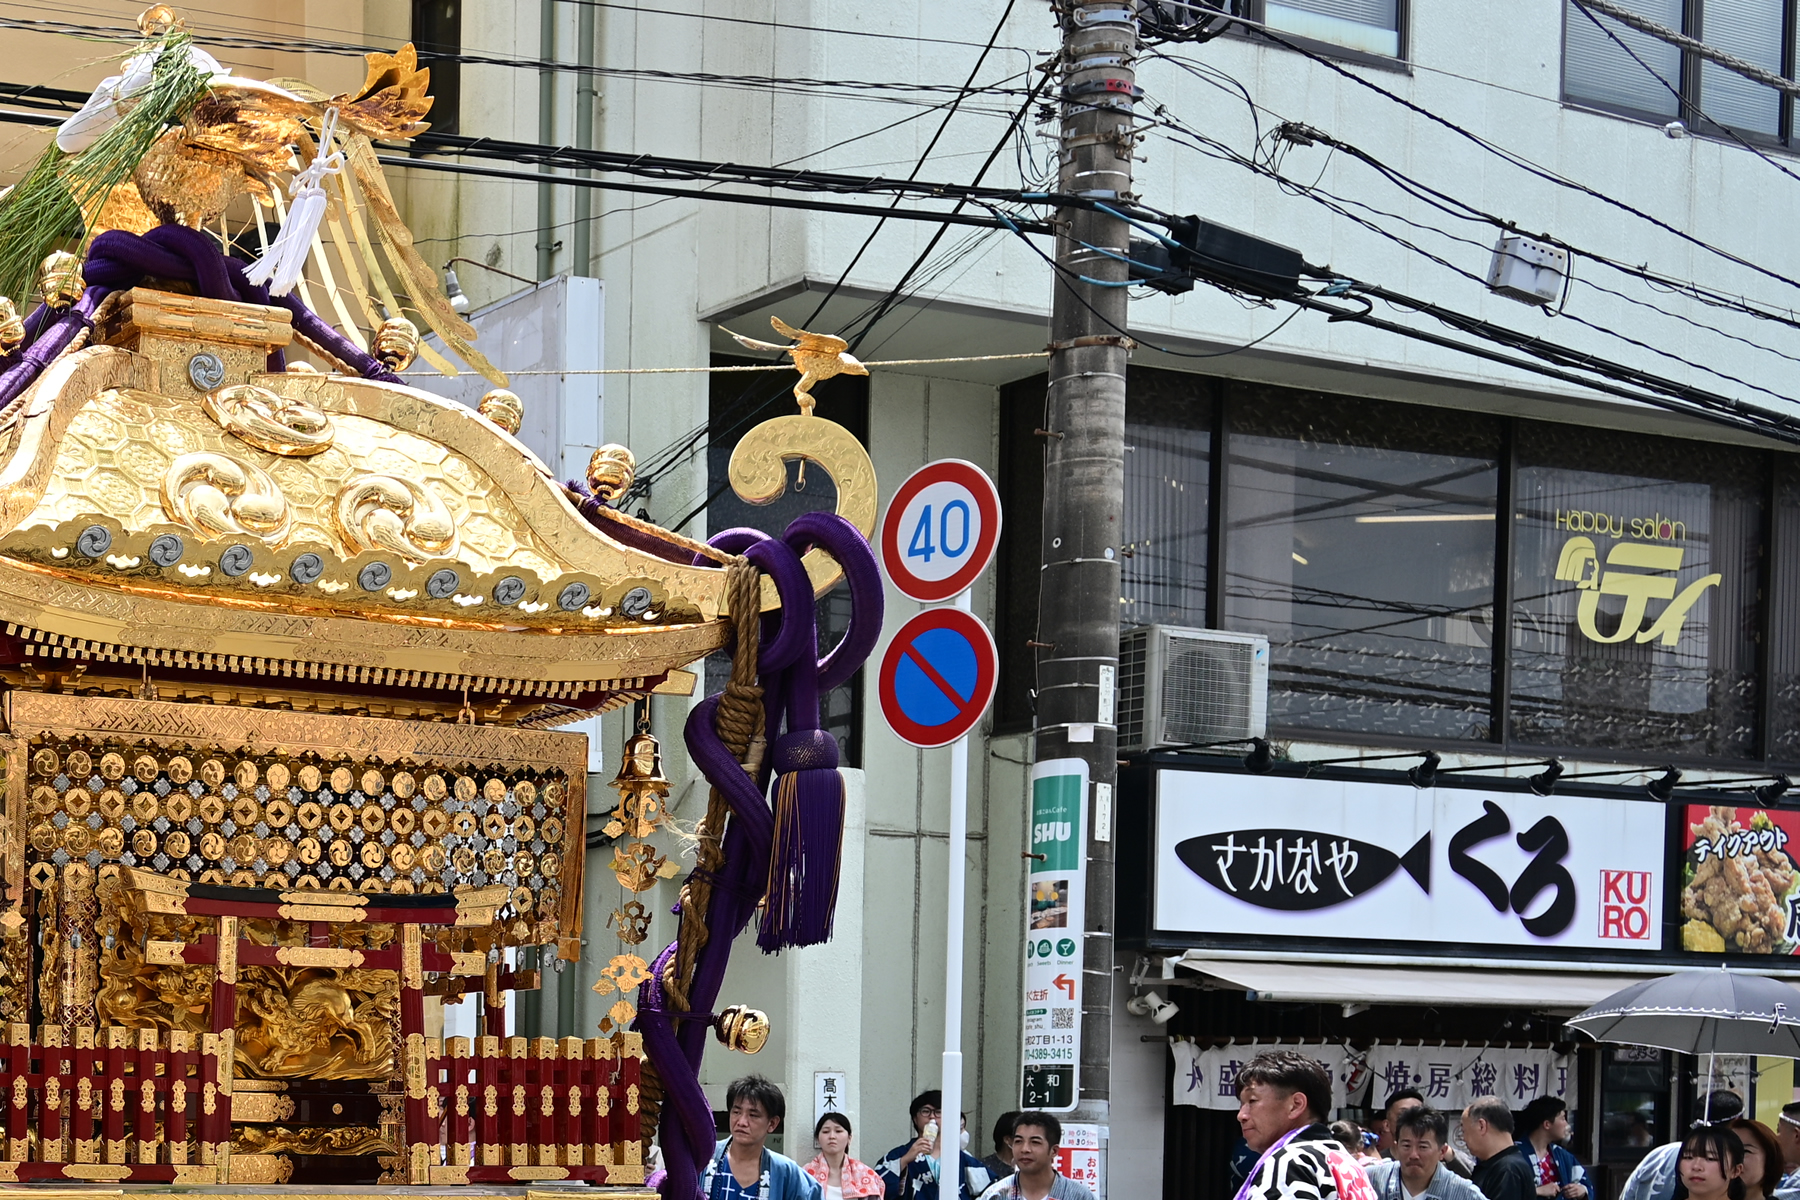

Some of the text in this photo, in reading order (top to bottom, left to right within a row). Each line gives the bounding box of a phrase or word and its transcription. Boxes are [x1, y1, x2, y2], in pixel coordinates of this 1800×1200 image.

[908, 499, 970, 563] 40
[1555, 508, 1686, 542] Happy salon
[1033, 821, 1072, 844] SHU
[1694, 826, 1789, 864] テイクアウト
[1211, 833, 1360, 897] さかなや
[1447, 799, 1578, 938] くろ
[1604, 871, 1648, 905] KU
[1603, 905, 1649, 939] RO
[1029, 1090, 1050, 1103] 2-1
